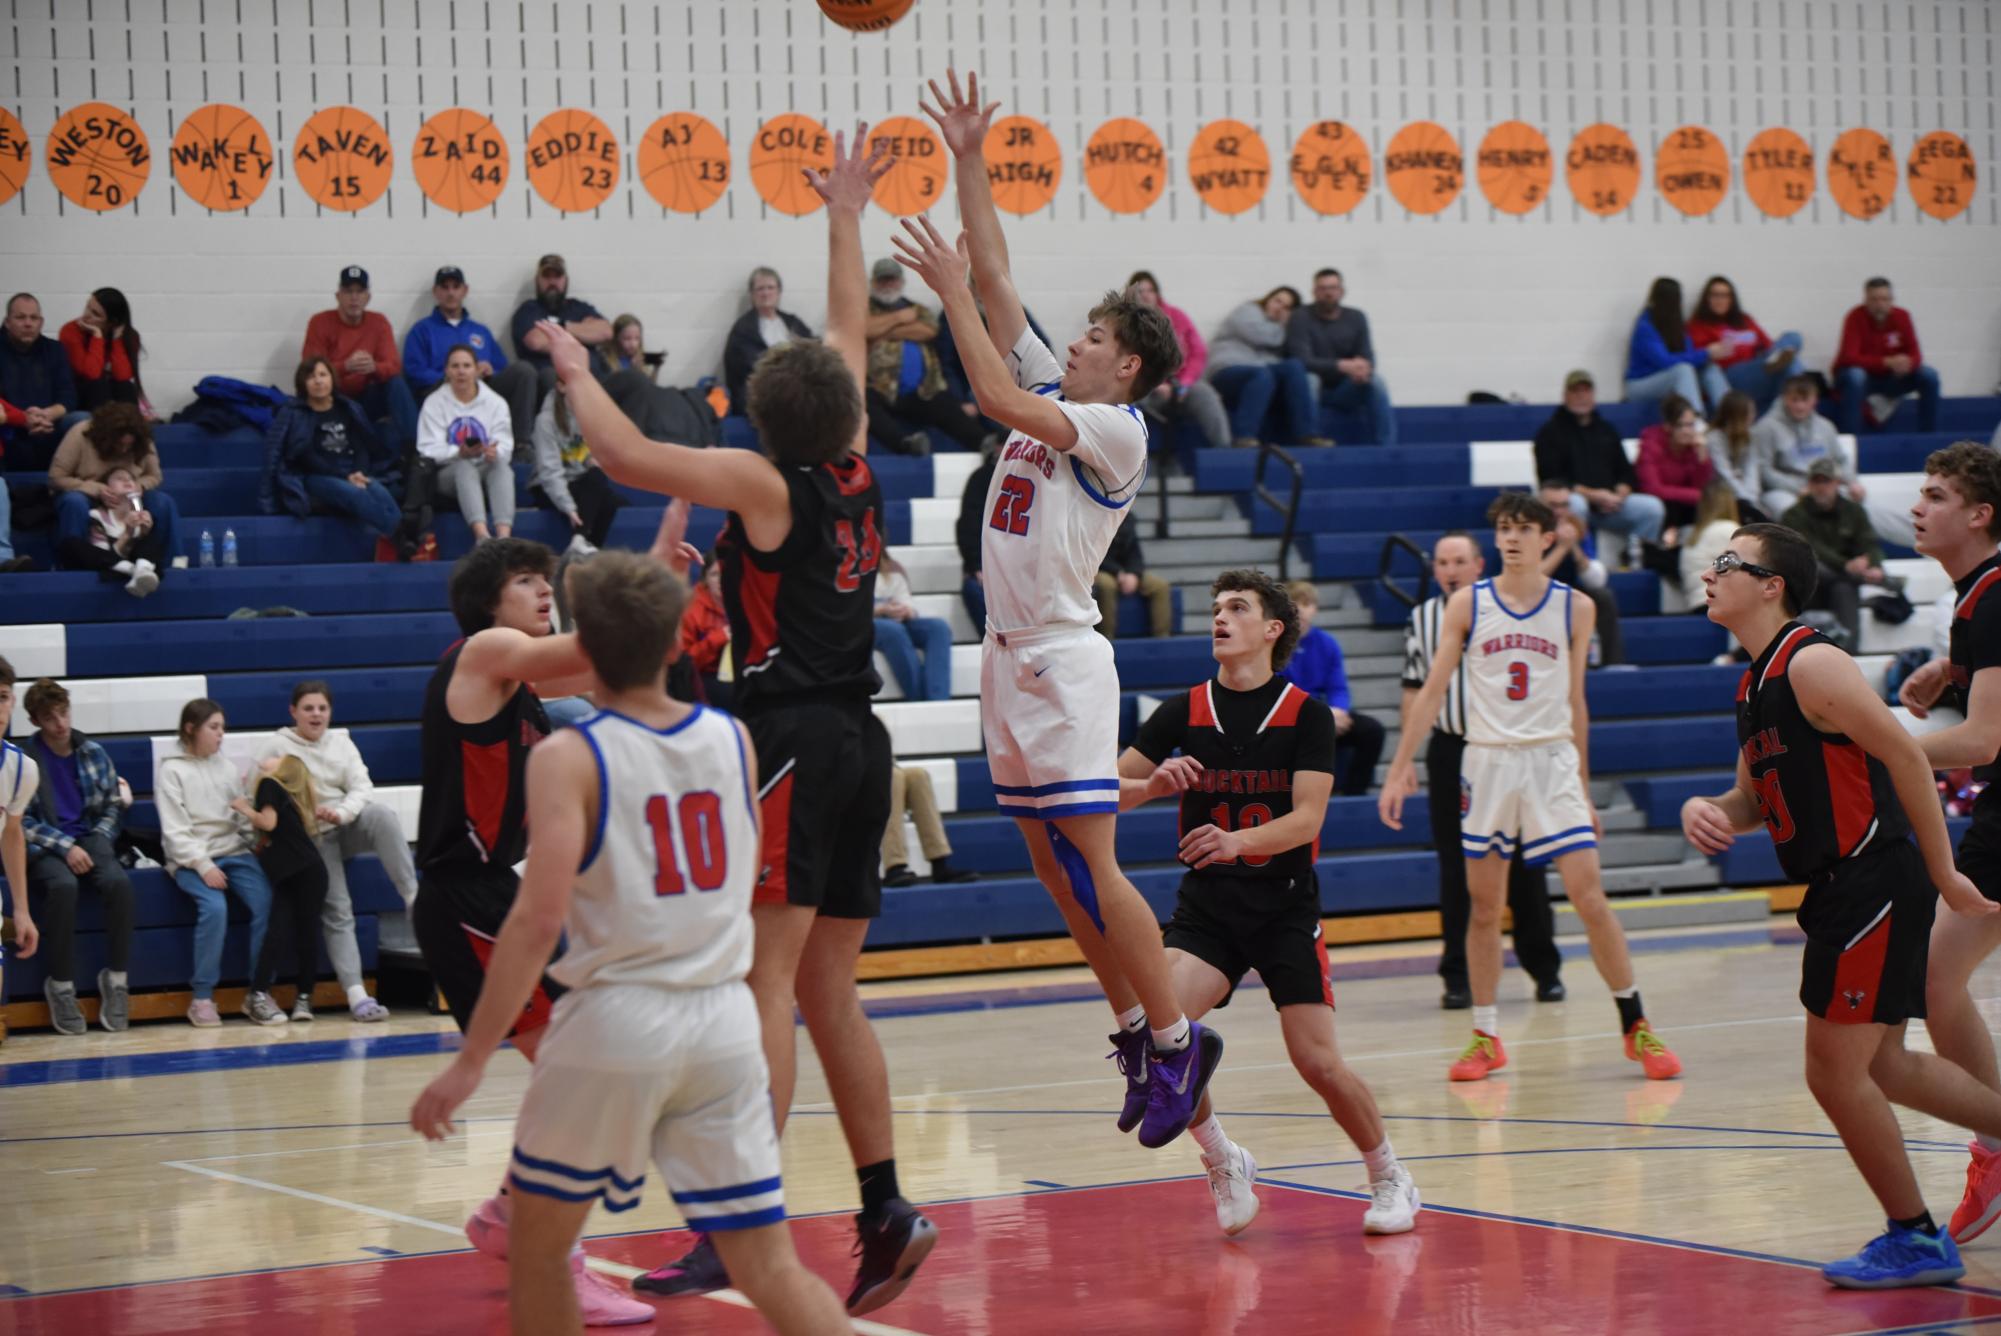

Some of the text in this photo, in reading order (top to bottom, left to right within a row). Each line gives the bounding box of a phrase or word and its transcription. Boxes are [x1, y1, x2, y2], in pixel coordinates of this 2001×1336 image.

[50, 117, 149, 167] WESTON
[298, 130, 388, 167] TAVEN
[421, 133, 500, 161] ZAID
[661, 124, 693, 149] AJ
[760, 127, 828, 156] COLE
[1005, 126, 1034, 147] JR
[1214, 136, 1240, 157] 42
[174, 134, 273, 179] WAKELY
[531, 132, 617, 168] EDDIE
[1088, 140, 1162, 167] HUTCH
[1477, 148, 1550, 169] HENRY
[1566, 143, 1637, 170] CADEN
[470, 164, 502, 184] 44
[581, 166, 612, 189] 23
[699, 160, 728, 183] 13
[1140, 174, 1154, 192] 4
[1193, 169, 1267, 192] WYATT
[1662, 170, 1722, 193] OWEN
[88, 175, 121, 206] 20
[228, 179, 241, 200] 1
[330, 176, 361, 197] 15
[920, 176, 934, 196] 3
[989, 473, 1035, 537] 22
[1481, 633, 1559, 661] WARRIORS
[1506, 661, 1529, 701] 3
[645, 789, 727, 897] 10
